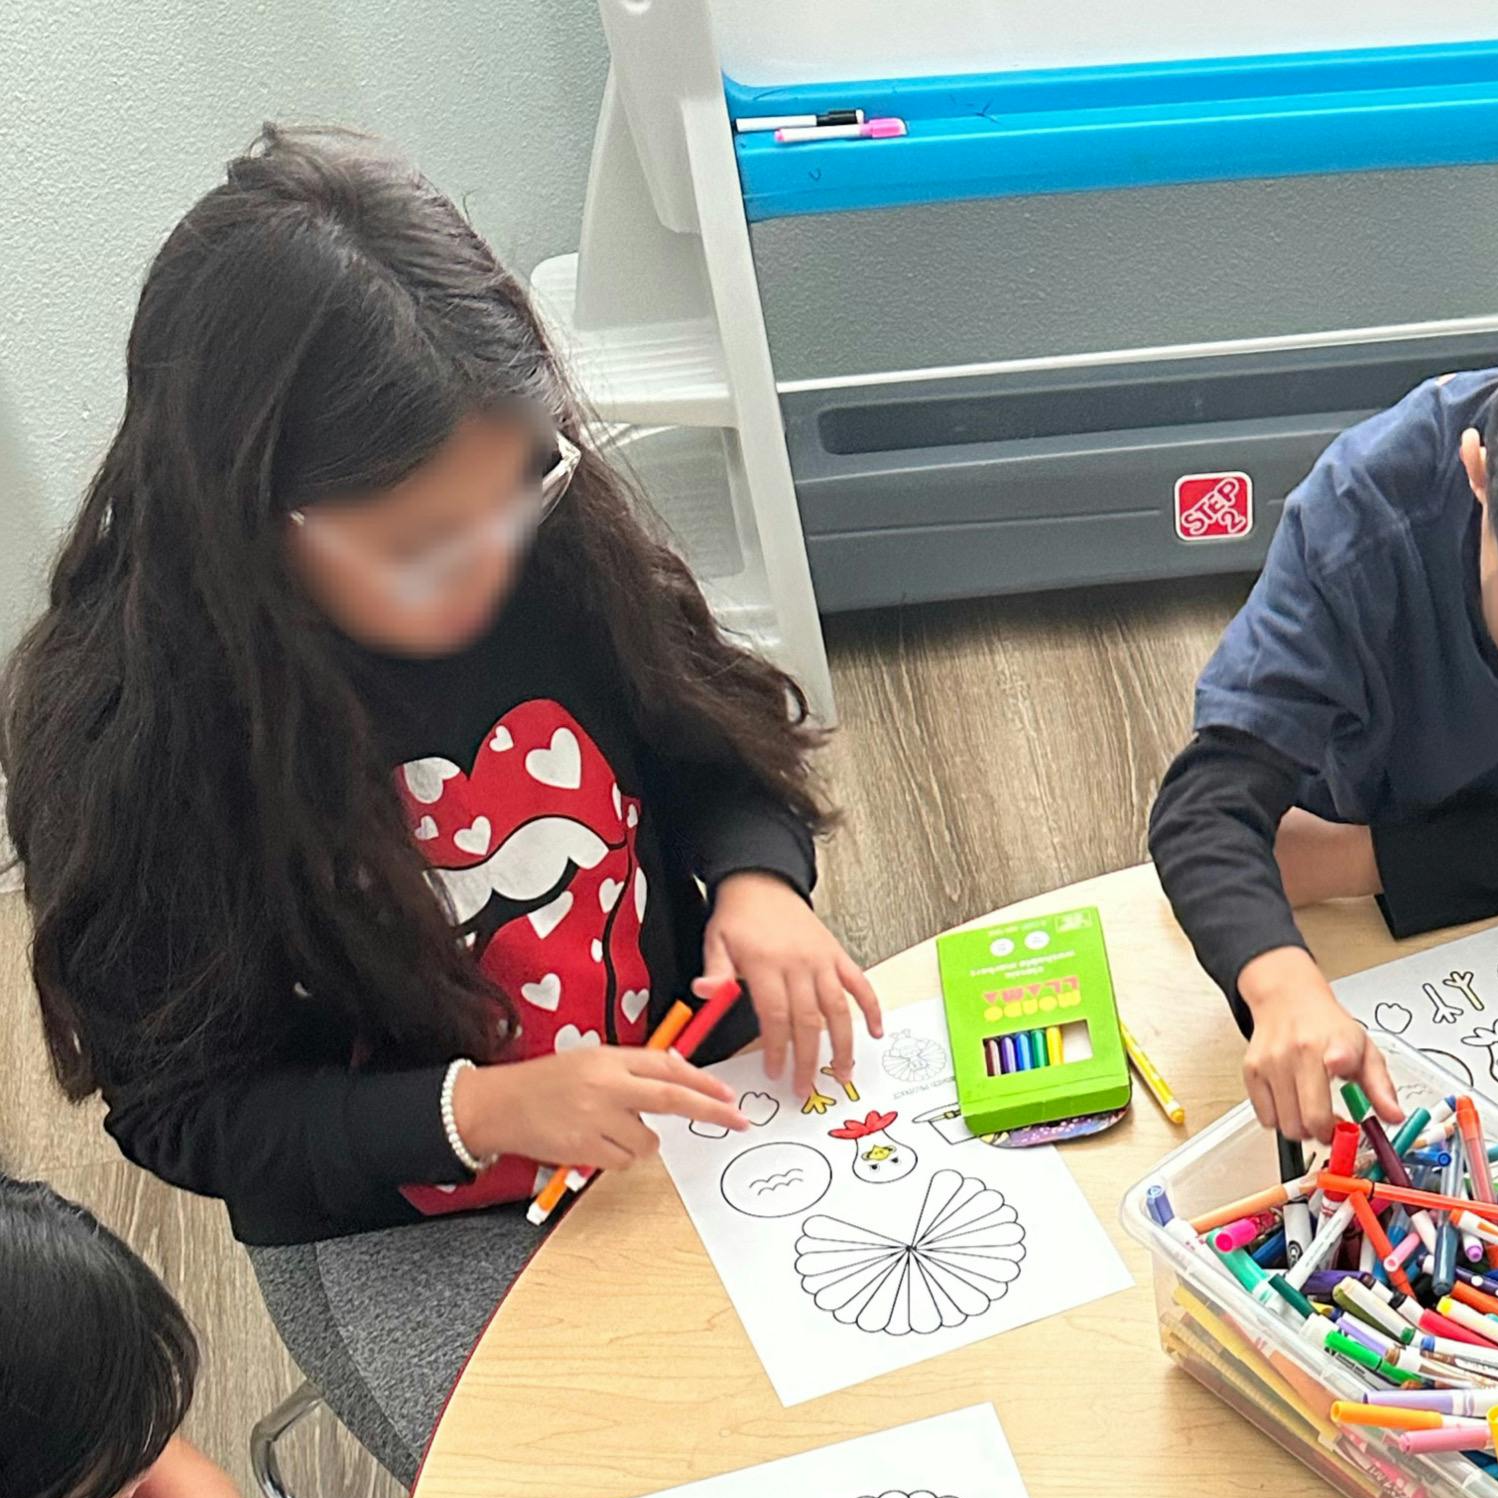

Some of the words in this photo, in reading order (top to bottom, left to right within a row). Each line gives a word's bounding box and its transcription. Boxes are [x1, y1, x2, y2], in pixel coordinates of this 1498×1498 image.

[1181, 478, 1240, 535] STEP
[1217, 508, 1247, 533] 2
[984, 975, 1079, 1005] LLAMA
